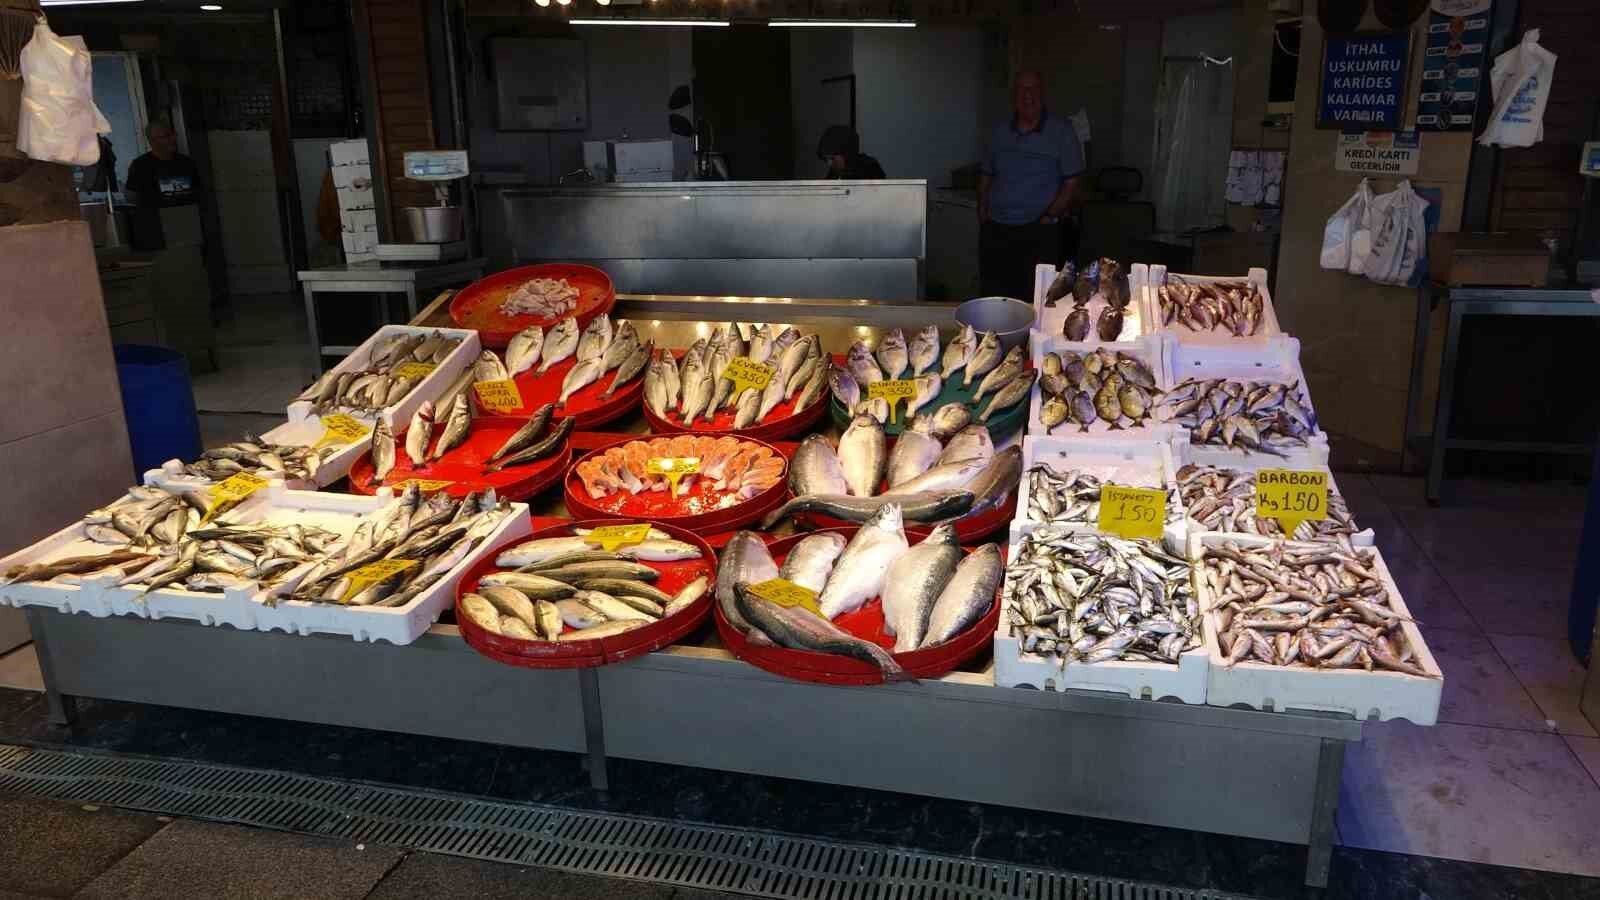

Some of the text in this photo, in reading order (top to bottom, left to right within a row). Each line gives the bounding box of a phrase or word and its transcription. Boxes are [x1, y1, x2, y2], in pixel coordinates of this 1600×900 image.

[1328, 59, 1401, 73] USKUMRU
[1333, 73, 1393, 89] KARİDES
[1327, 94, 1396, 105] KALAMAR
[1259, 472, 1323, 485] BARBON
[1259, 491, 1320, 512] Kg 150
[1112, 503, 1156, 522] 150
